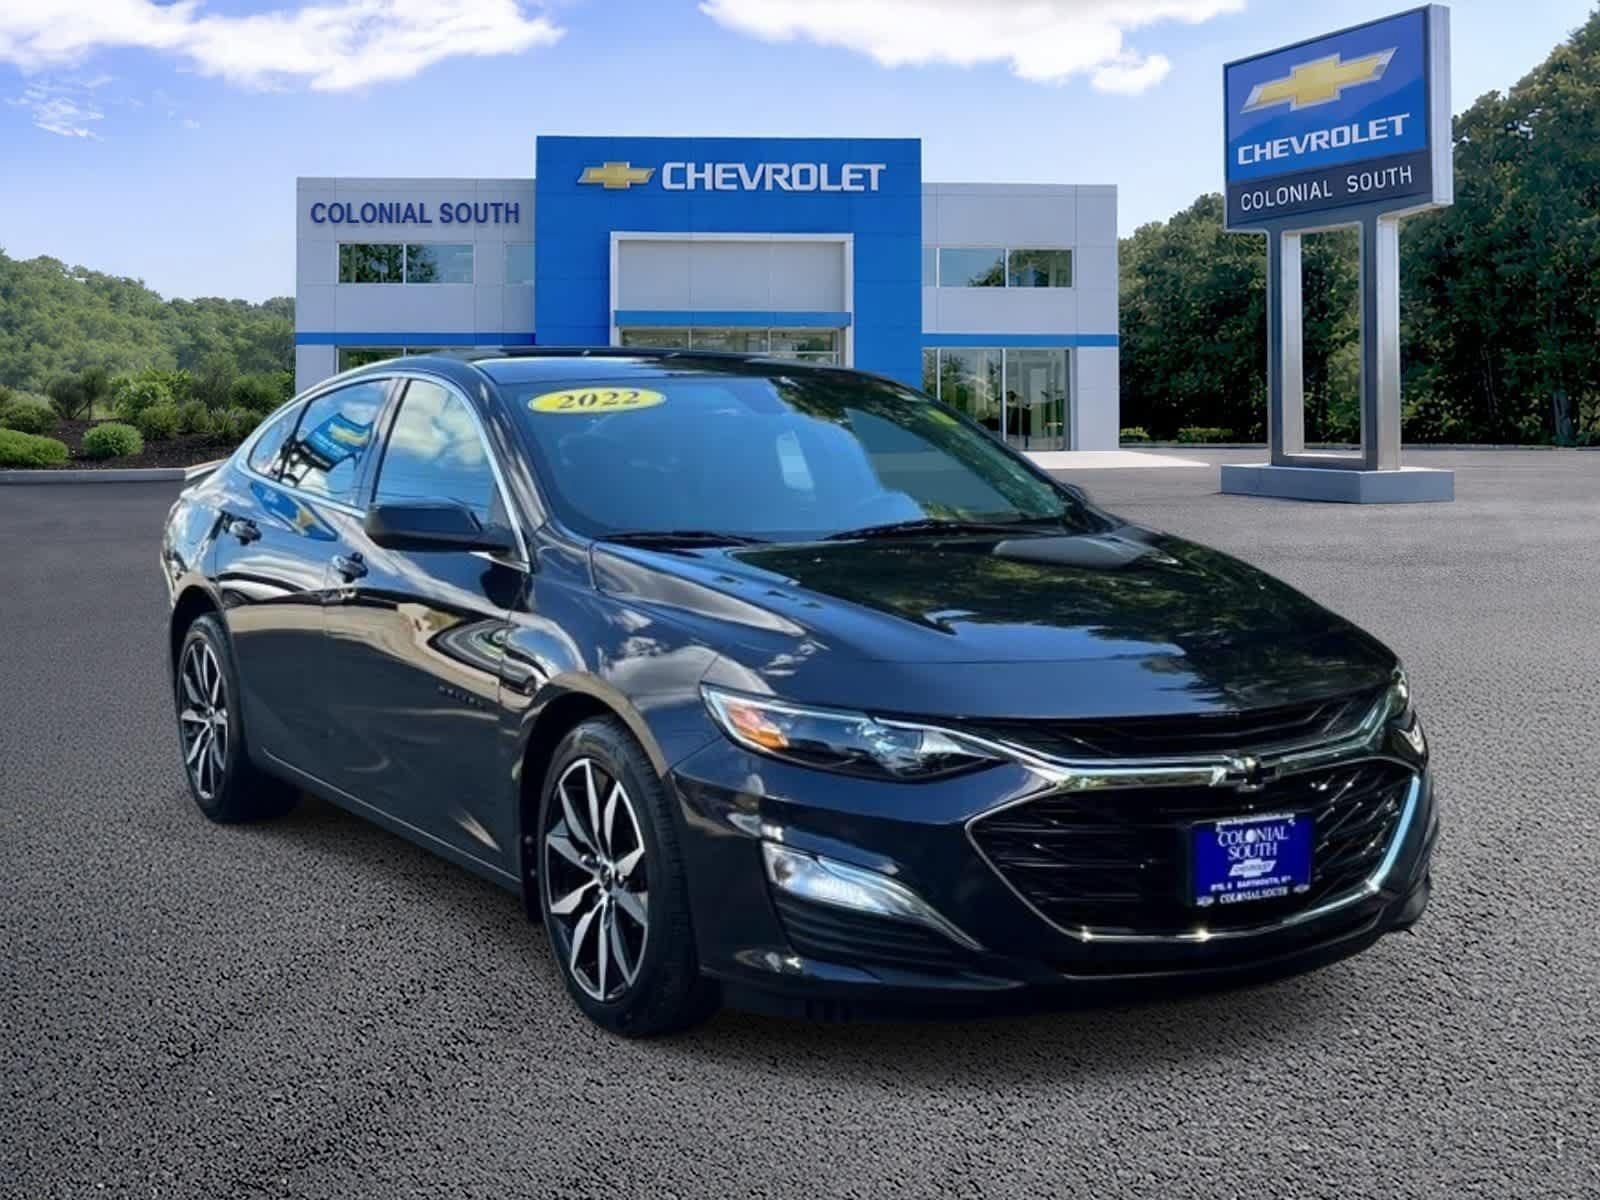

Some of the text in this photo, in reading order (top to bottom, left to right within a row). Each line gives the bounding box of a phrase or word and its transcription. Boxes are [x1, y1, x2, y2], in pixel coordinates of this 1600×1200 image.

[1237, 112, 1410, 166] CHEVROLET
[661, 161, 887, 192] CHEVROLET
[1240, 165, 1413, 212] COLONIAL SOUTH
[310, 202, 520, 224] COLONIAL SOUTH
[558, 391, 640, 409] 2022
[1217, 825, 1289, 847] COLONIAL
[1227, 842, 1278, 861] SOUTH
